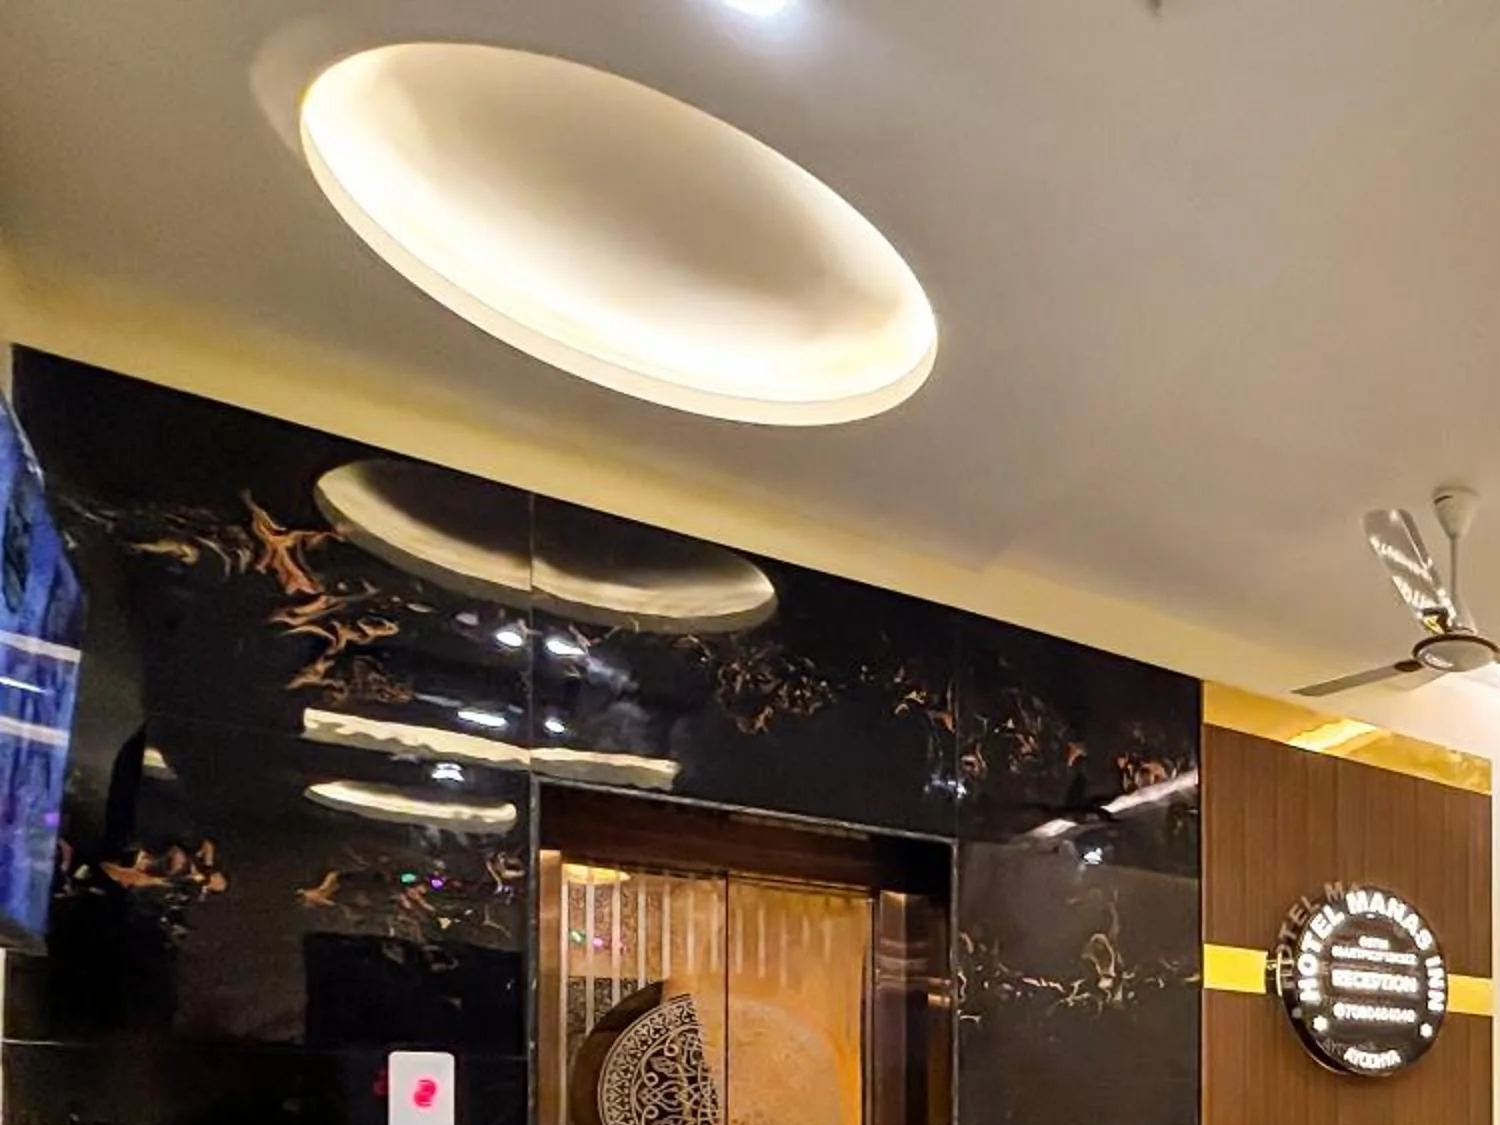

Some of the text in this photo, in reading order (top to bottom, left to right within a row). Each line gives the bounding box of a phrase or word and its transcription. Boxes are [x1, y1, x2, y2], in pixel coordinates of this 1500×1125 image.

[1297, 890, 1446, 1012] HOTEL MANAS INN
[1343, 1047, 1402, 1069] AYODHYA
